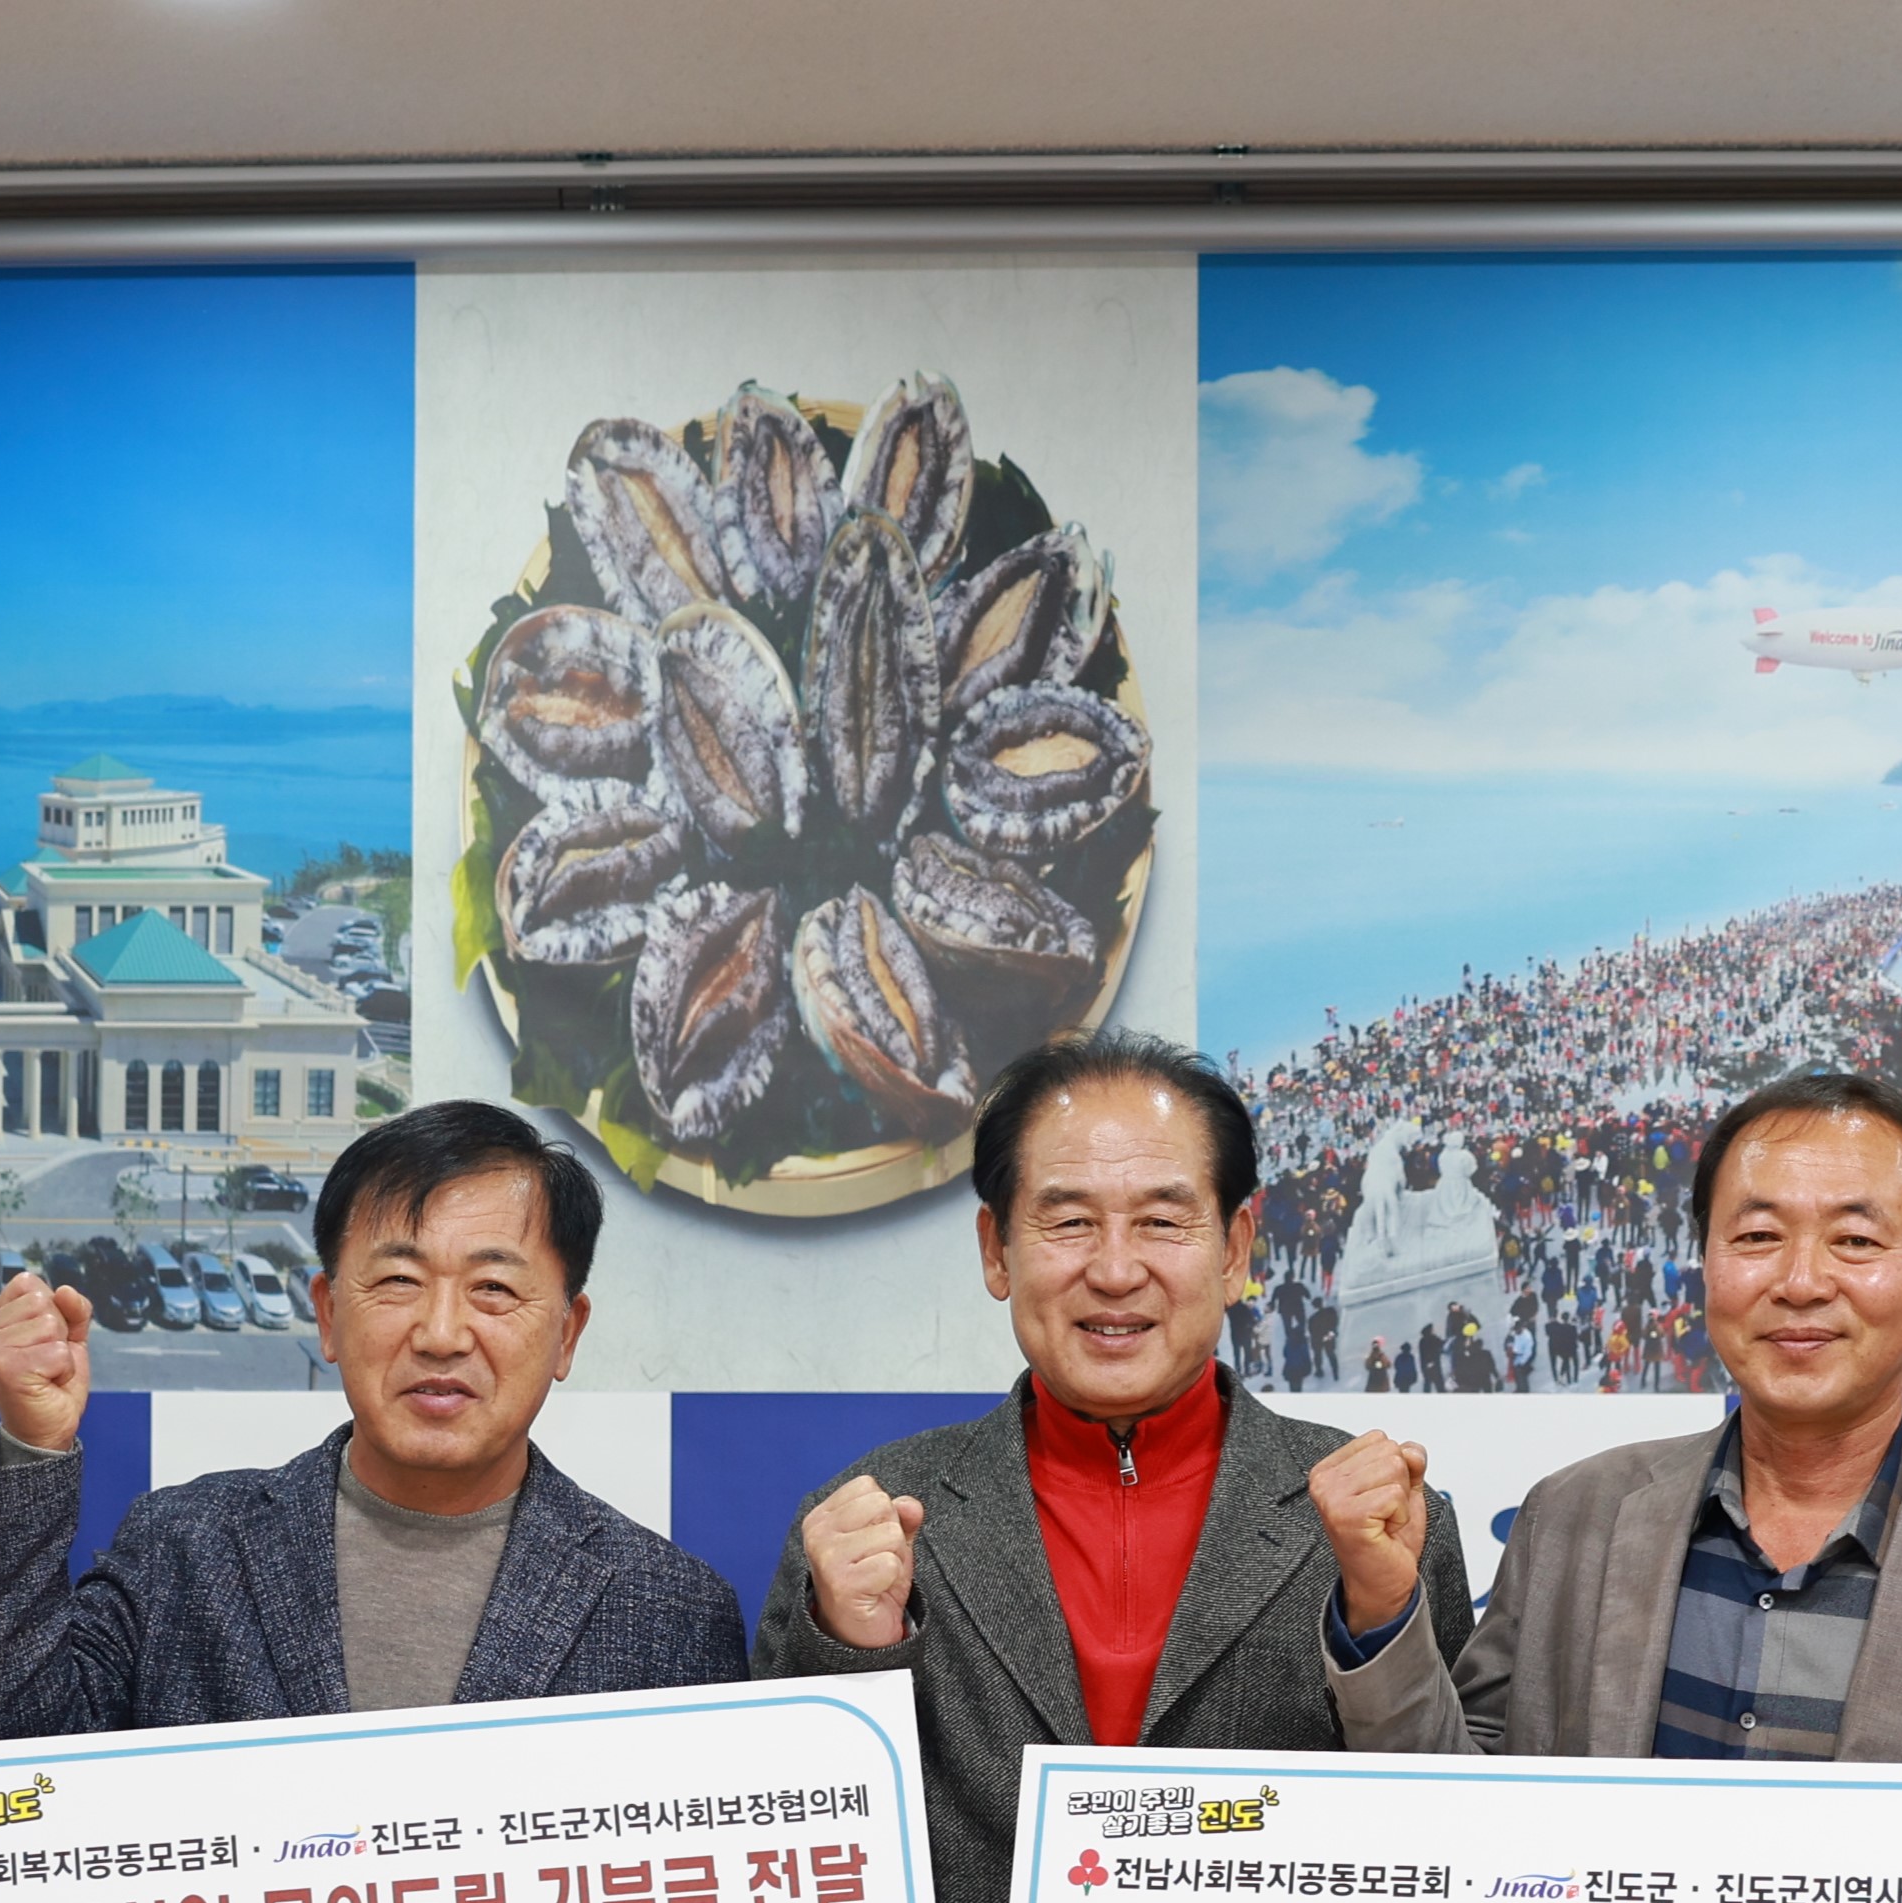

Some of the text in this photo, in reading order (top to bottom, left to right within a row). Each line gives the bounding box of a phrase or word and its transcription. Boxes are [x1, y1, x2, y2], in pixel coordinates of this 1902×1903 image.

[1810, 630, 1859, 645] Welcome
[1069, 1787, 1194, 1815] 군민이 주인!
[1101, 1798, 1266, 1838] 살기좋은 진도
[273, 1839, 351, 1863] Jindo
[372, 1818, 461, 1855] 진도군
[500, 1785, 869, 1844] 진도군지역사회보장협의체
[1115, 1858, 1450, 1898] 전남사회복지공동모금회
[1484, 1877, 1564, 1899] Jindo
[1585, 1871, 1677, 1903] 진도군
